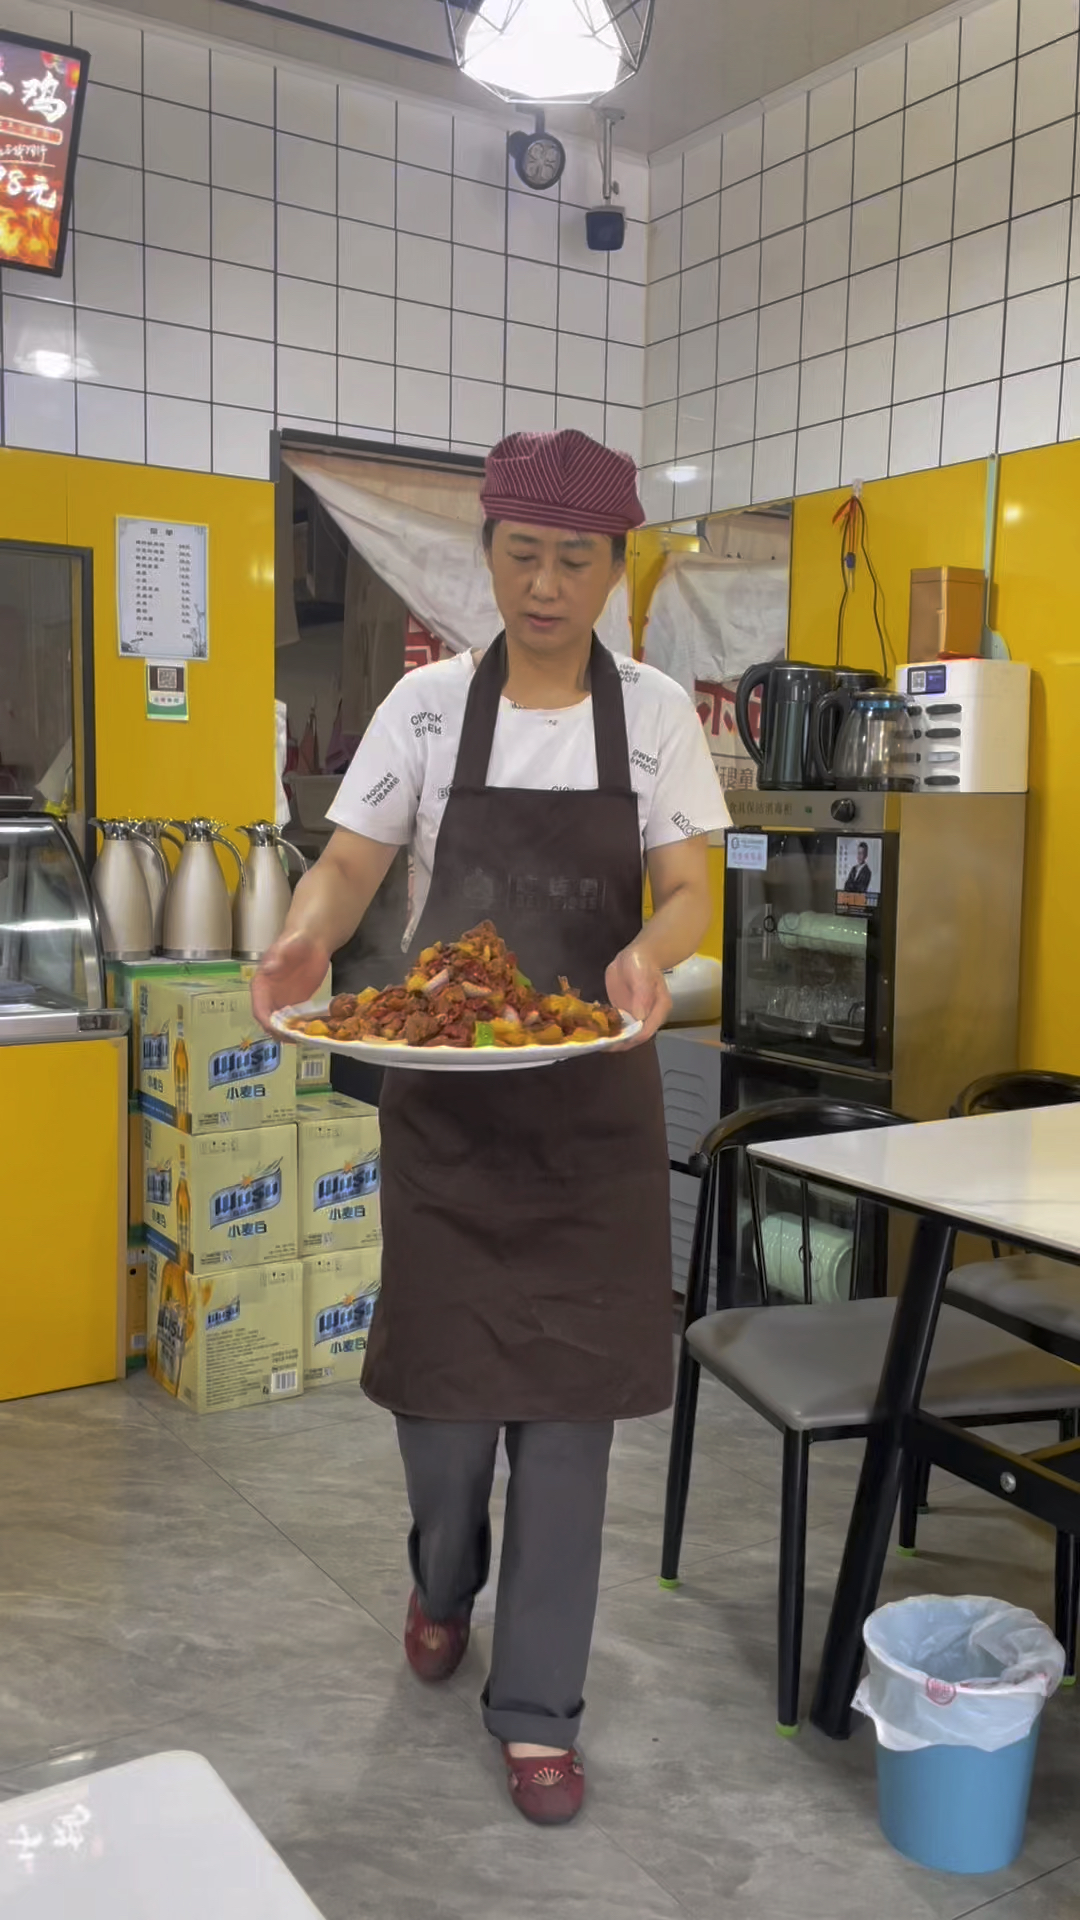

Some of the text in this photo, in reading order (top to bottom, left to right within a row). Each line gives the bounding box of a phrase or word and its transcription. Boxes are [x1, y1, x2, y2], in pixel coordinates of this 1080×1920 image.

[0, 165, 57, 209] 8元
[226, 1084, 266, 1100] 小麦白
[329, 1204, 366, 1221] 小麦白
[228, 1220, 267, 1238] 小麦白
[330, 1337, 367, 1354] 小麦白
